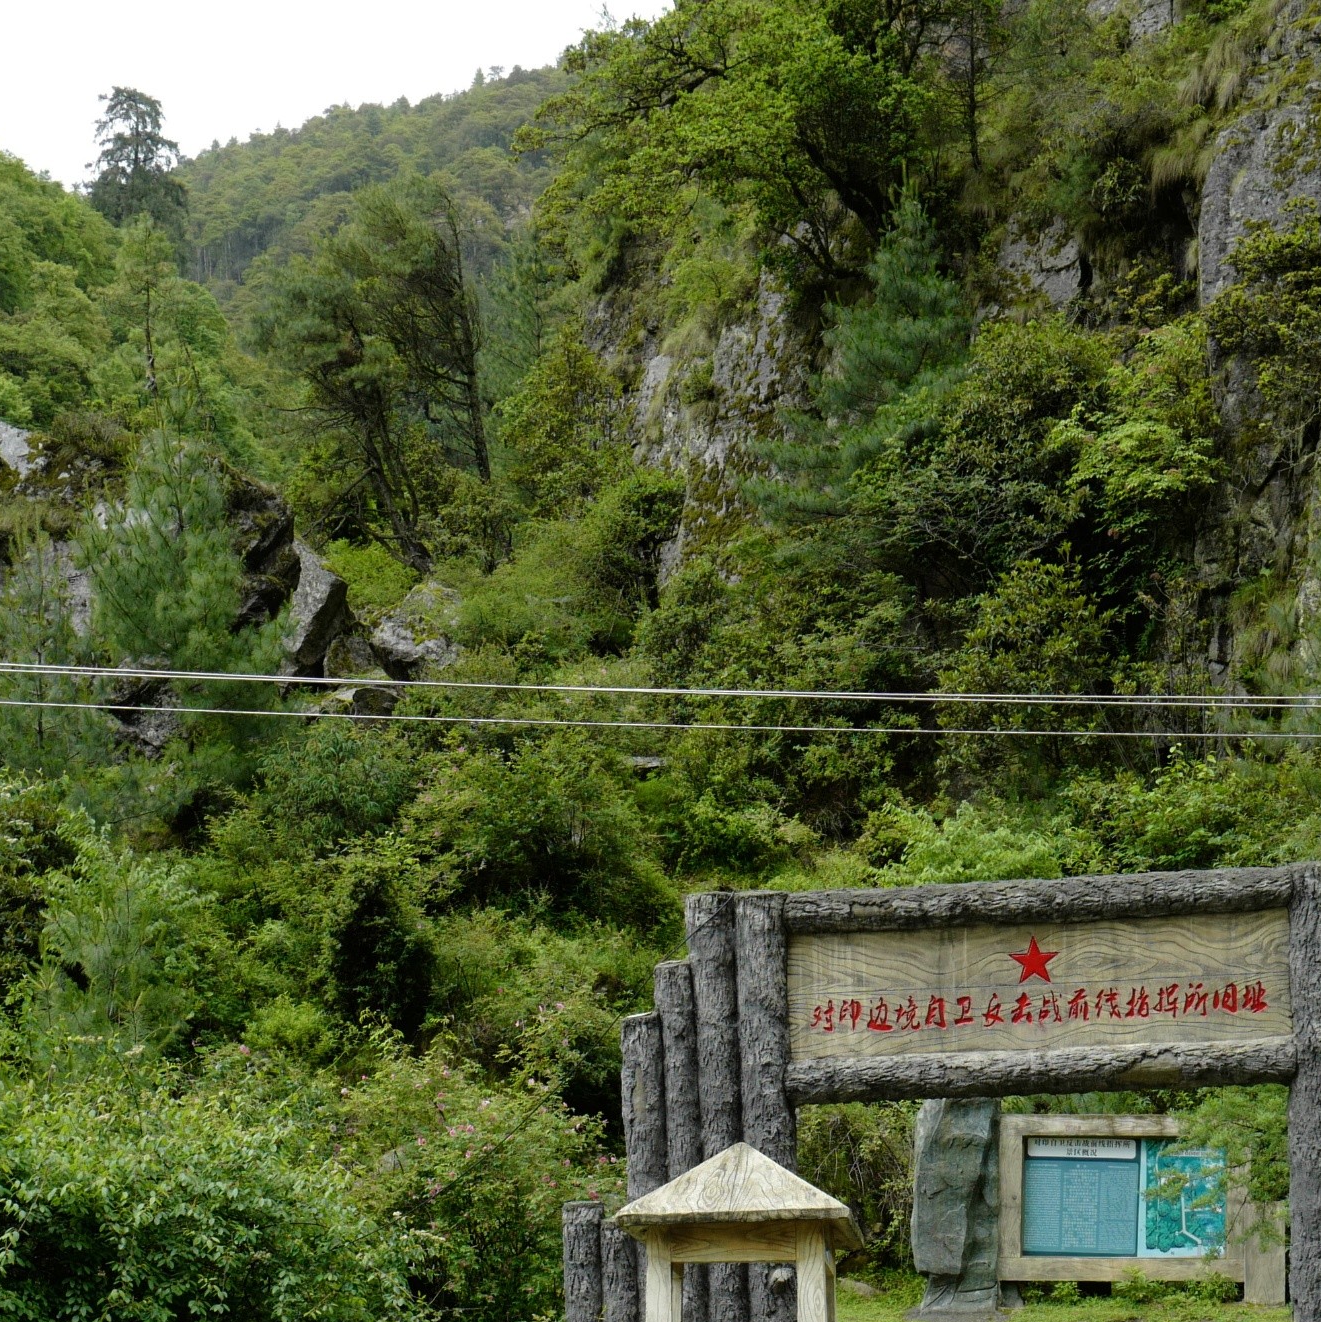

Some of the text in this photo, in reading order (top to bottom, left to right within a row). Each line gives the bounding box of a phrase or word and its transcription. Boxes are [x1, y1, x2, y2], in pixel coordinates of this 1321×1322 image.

[810, 980, 1269, 1032] 对印边境自卫反击战前线指挥所旧址
